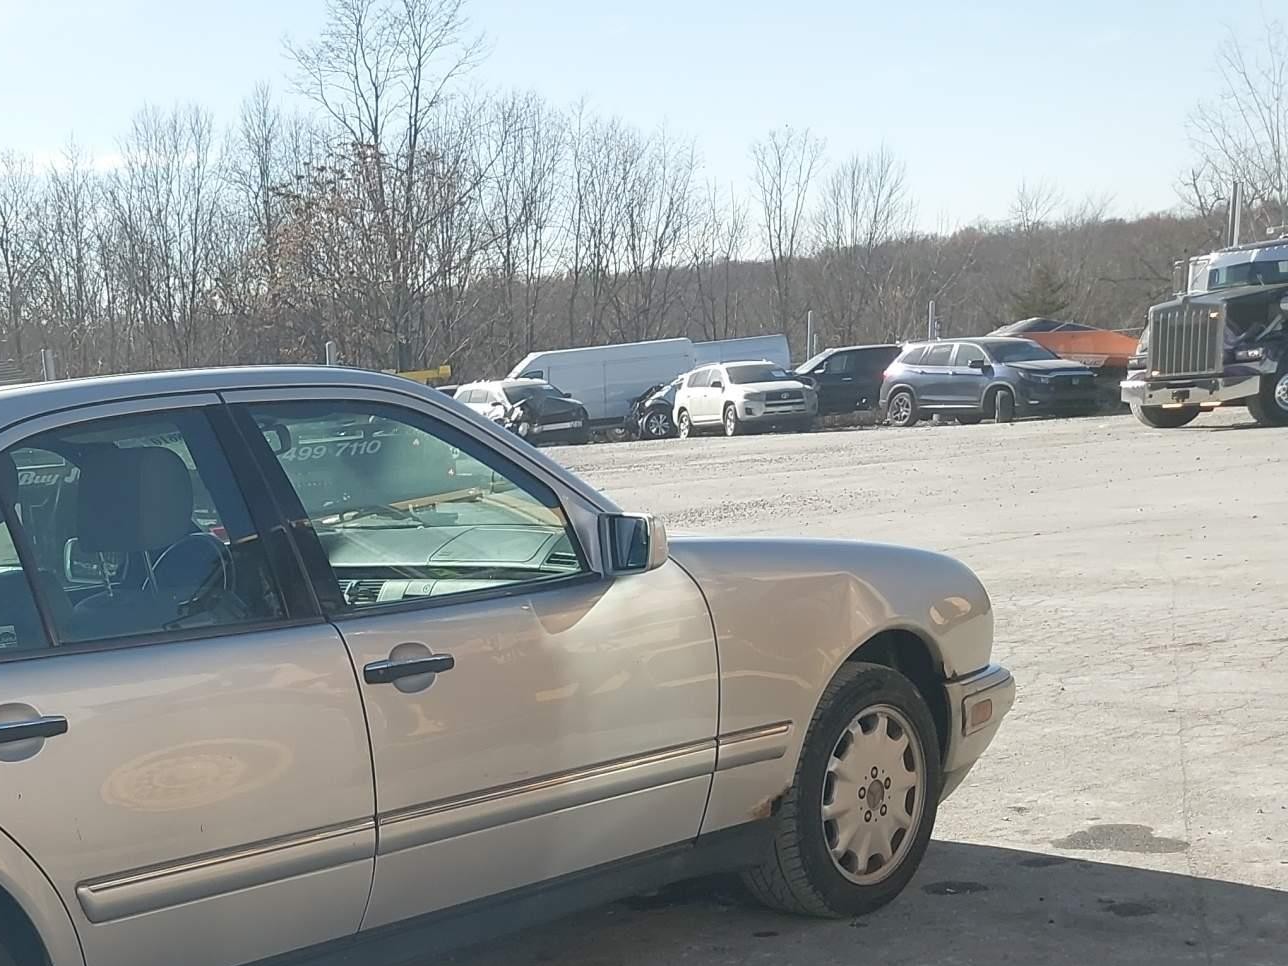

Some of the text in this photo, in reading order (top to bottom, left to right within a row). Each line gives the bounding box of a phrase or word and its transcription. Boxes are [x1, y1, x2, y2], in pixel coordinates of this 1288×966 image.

[282, 440, 382, 461] 499 7110
[18, 471, 59, 486] Buy
